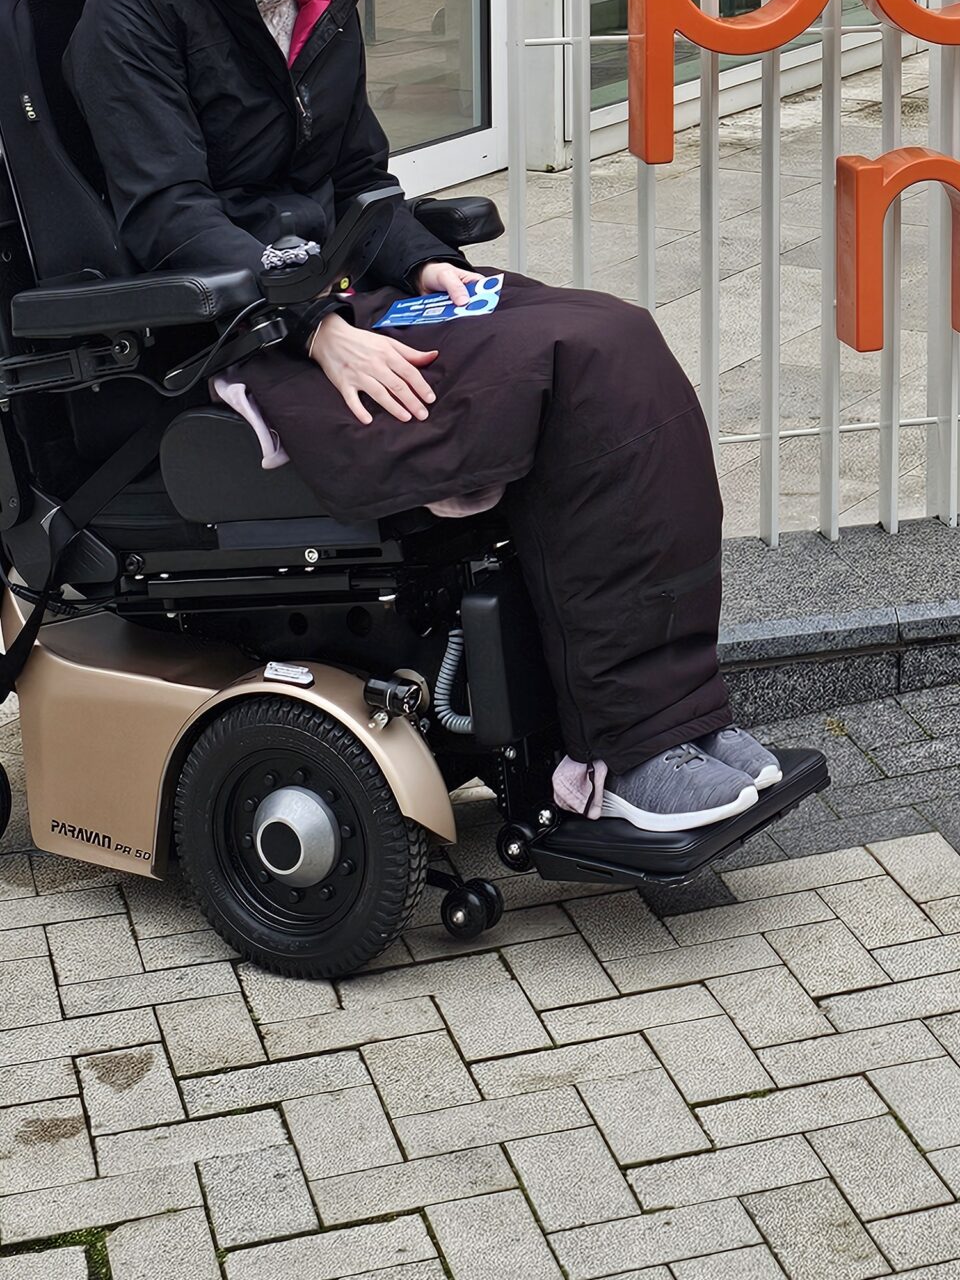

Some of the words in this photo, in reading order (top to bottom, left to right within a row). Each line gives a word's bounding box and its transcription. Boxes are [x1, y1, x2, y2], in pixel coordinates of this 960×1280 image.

[51, 819, 112, 849] PARAVAN
[114, 843, 132, 855] PR
[134, 849, 152, 860] 50
